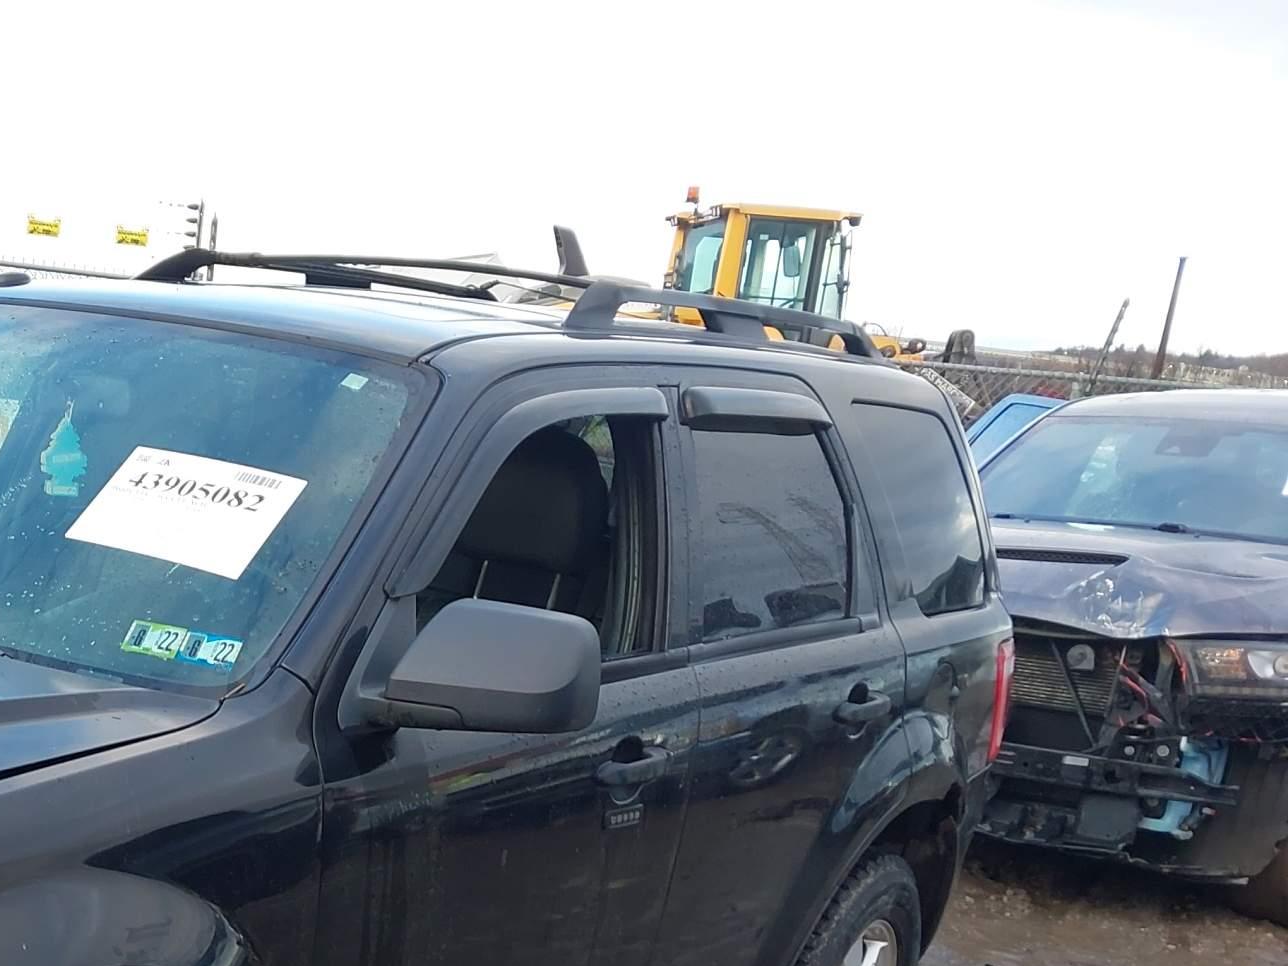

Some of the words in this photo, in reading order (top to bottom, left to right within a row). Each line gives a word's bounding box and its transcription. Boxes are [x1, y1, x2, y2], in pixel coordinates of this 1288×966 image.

[128, 471, 265, 512] 43905082
[158, 631, 179, 651] 22
[214, 642, 235, 663] 22
